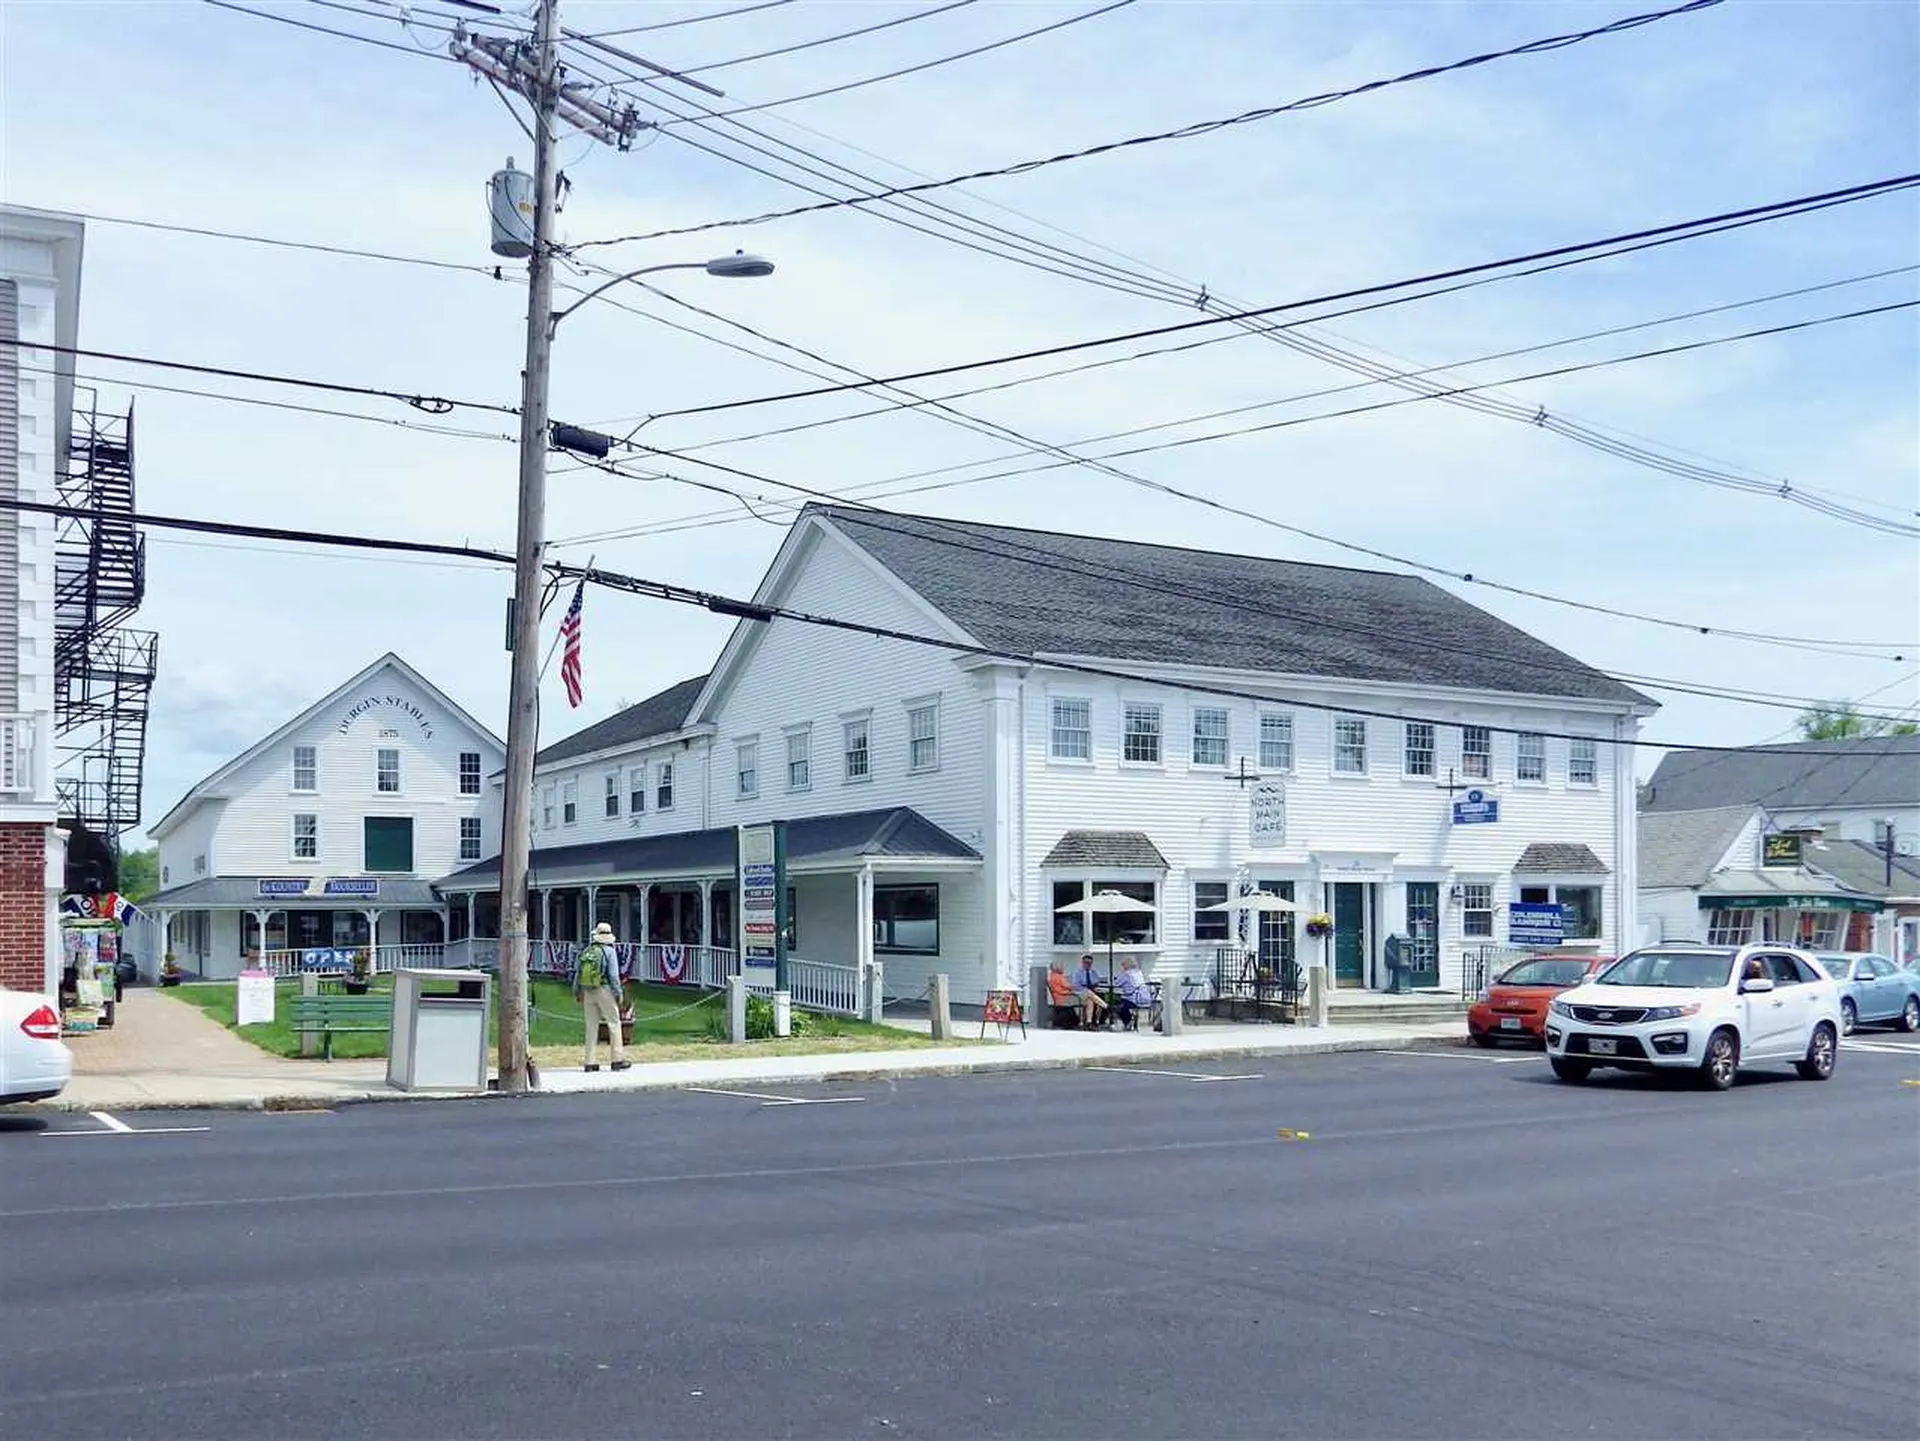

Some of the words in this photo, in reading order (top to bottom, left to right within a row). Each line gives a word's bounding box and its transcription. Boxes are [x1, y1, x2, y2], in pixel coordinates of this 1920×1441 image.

[338, 697, 380, 735] DURGIN
[1251, 796, 1284, 807] NORTH
[1256, 810, 1280, 819] MAIN
[304, 951, 356, 965] OPEN
